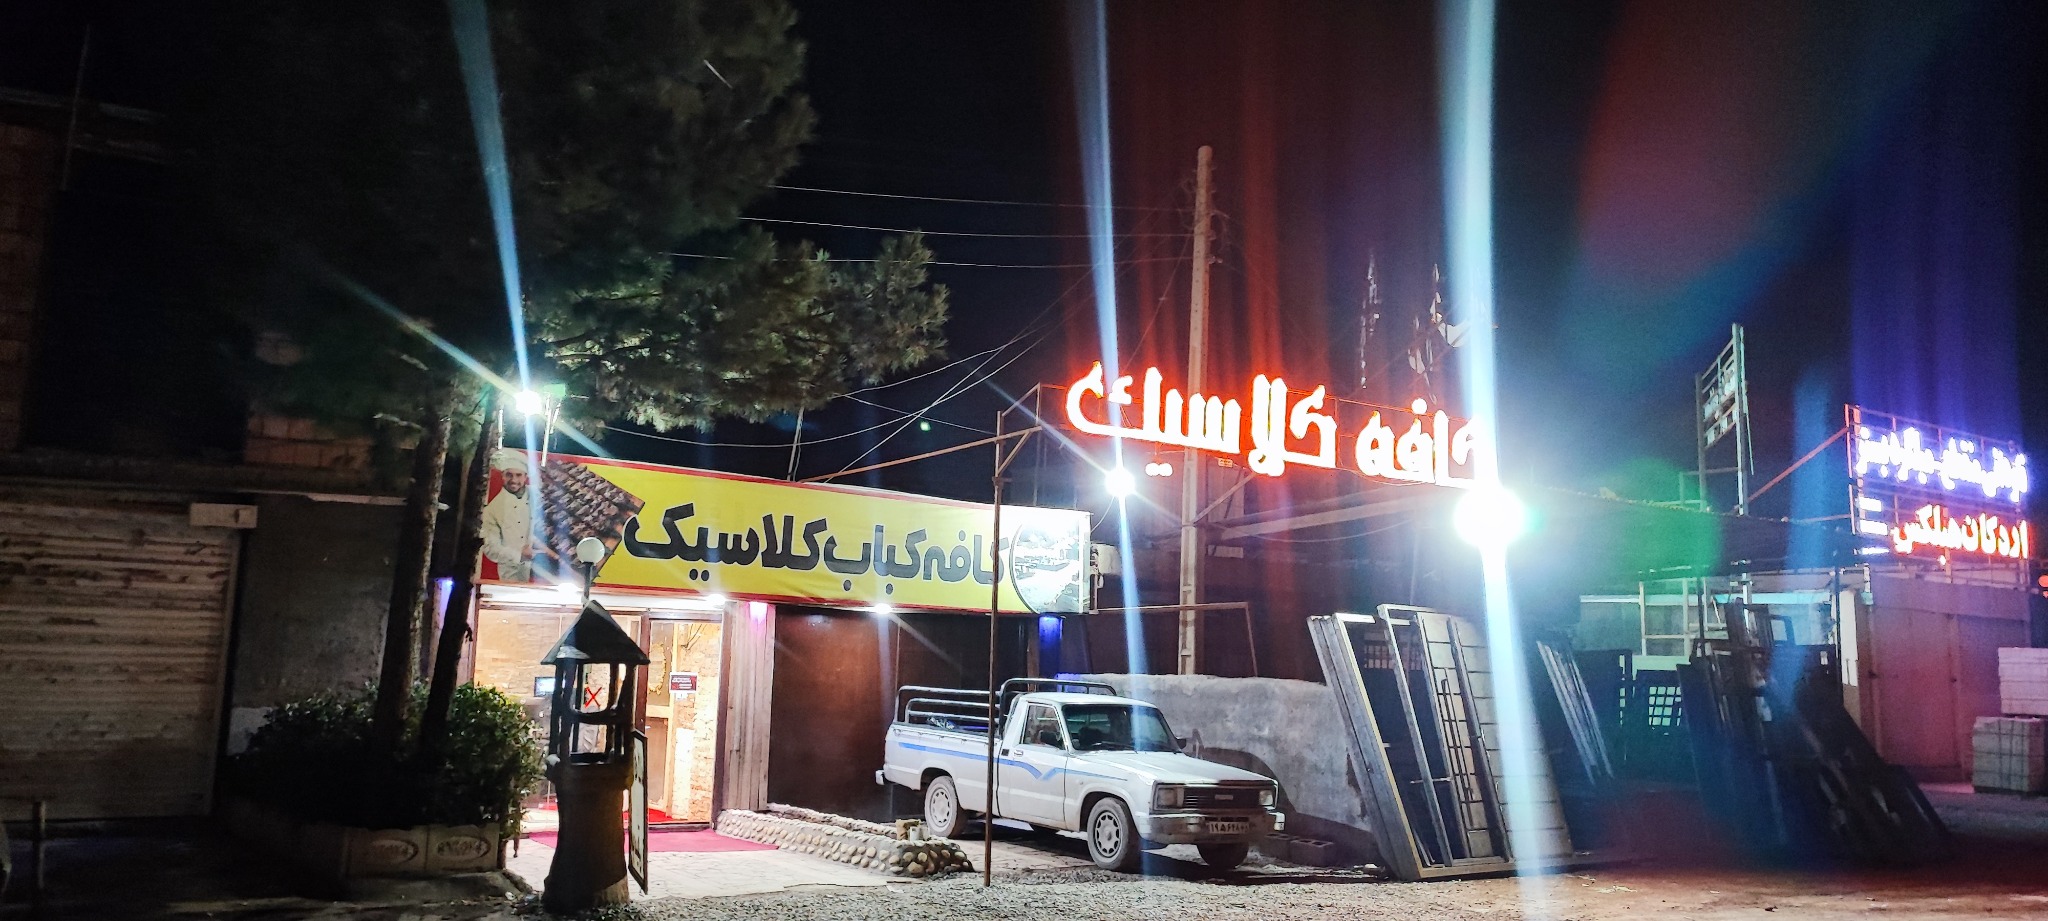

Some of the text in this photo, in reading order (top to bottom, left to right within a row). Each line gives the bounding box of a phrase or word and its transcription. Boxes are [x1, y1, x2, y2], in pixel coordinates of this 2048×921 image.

[623, 503, 1009, 595] کافه کباب کلاسیک
